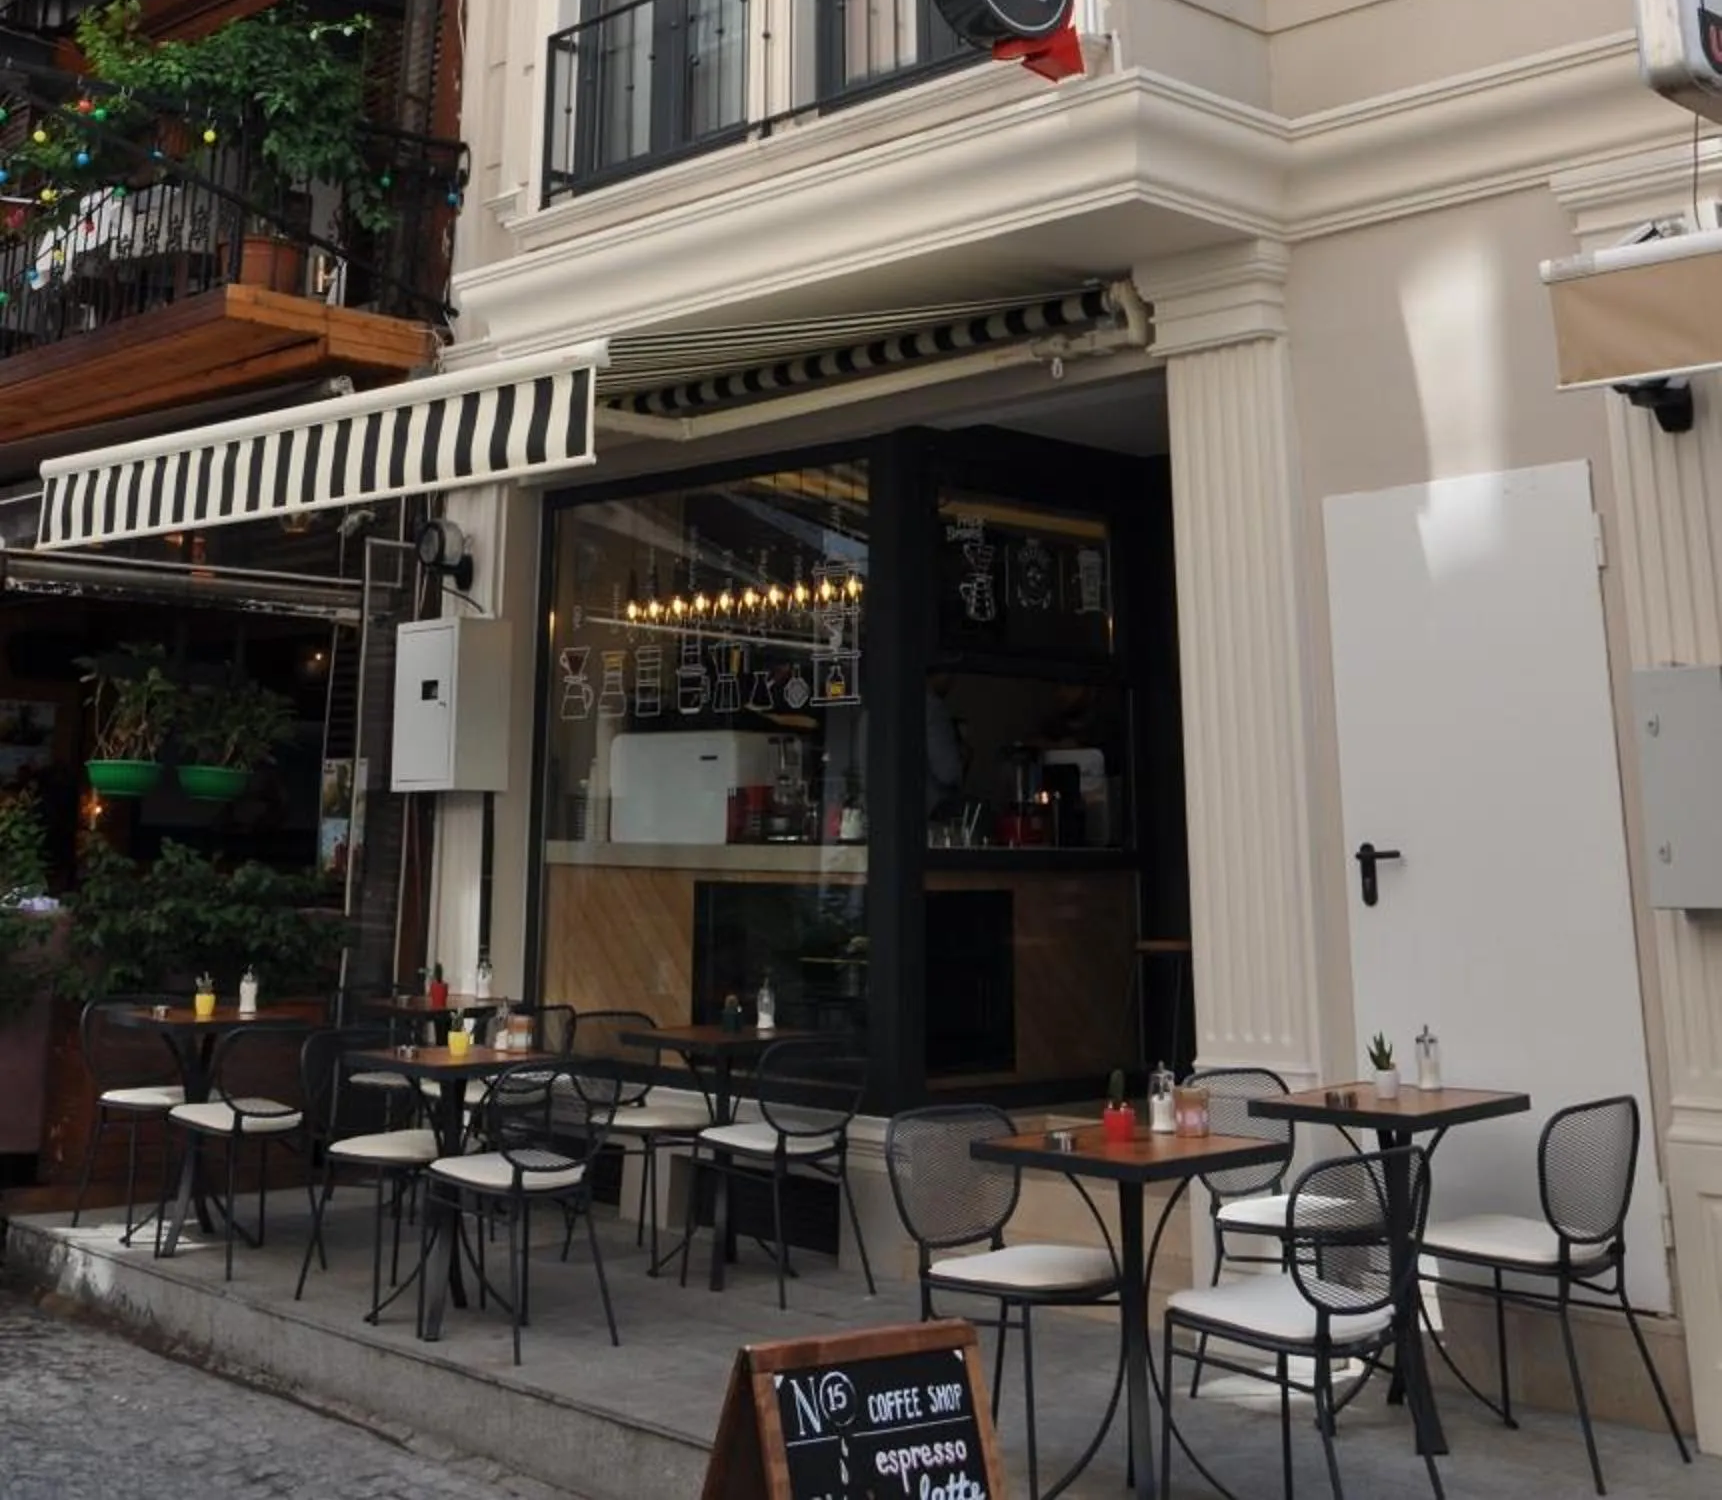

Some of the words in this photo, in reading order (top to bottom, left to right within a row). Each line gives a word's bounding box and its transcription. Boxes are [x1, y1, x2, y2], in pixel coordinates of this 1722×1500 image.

[867, 1385, 923, 1424] COFFEE
[927, 1383, 963, 1413] SHOP
[875, 1439, 967, 1494] espresso
[919, 1473, 986, 1500] latte
